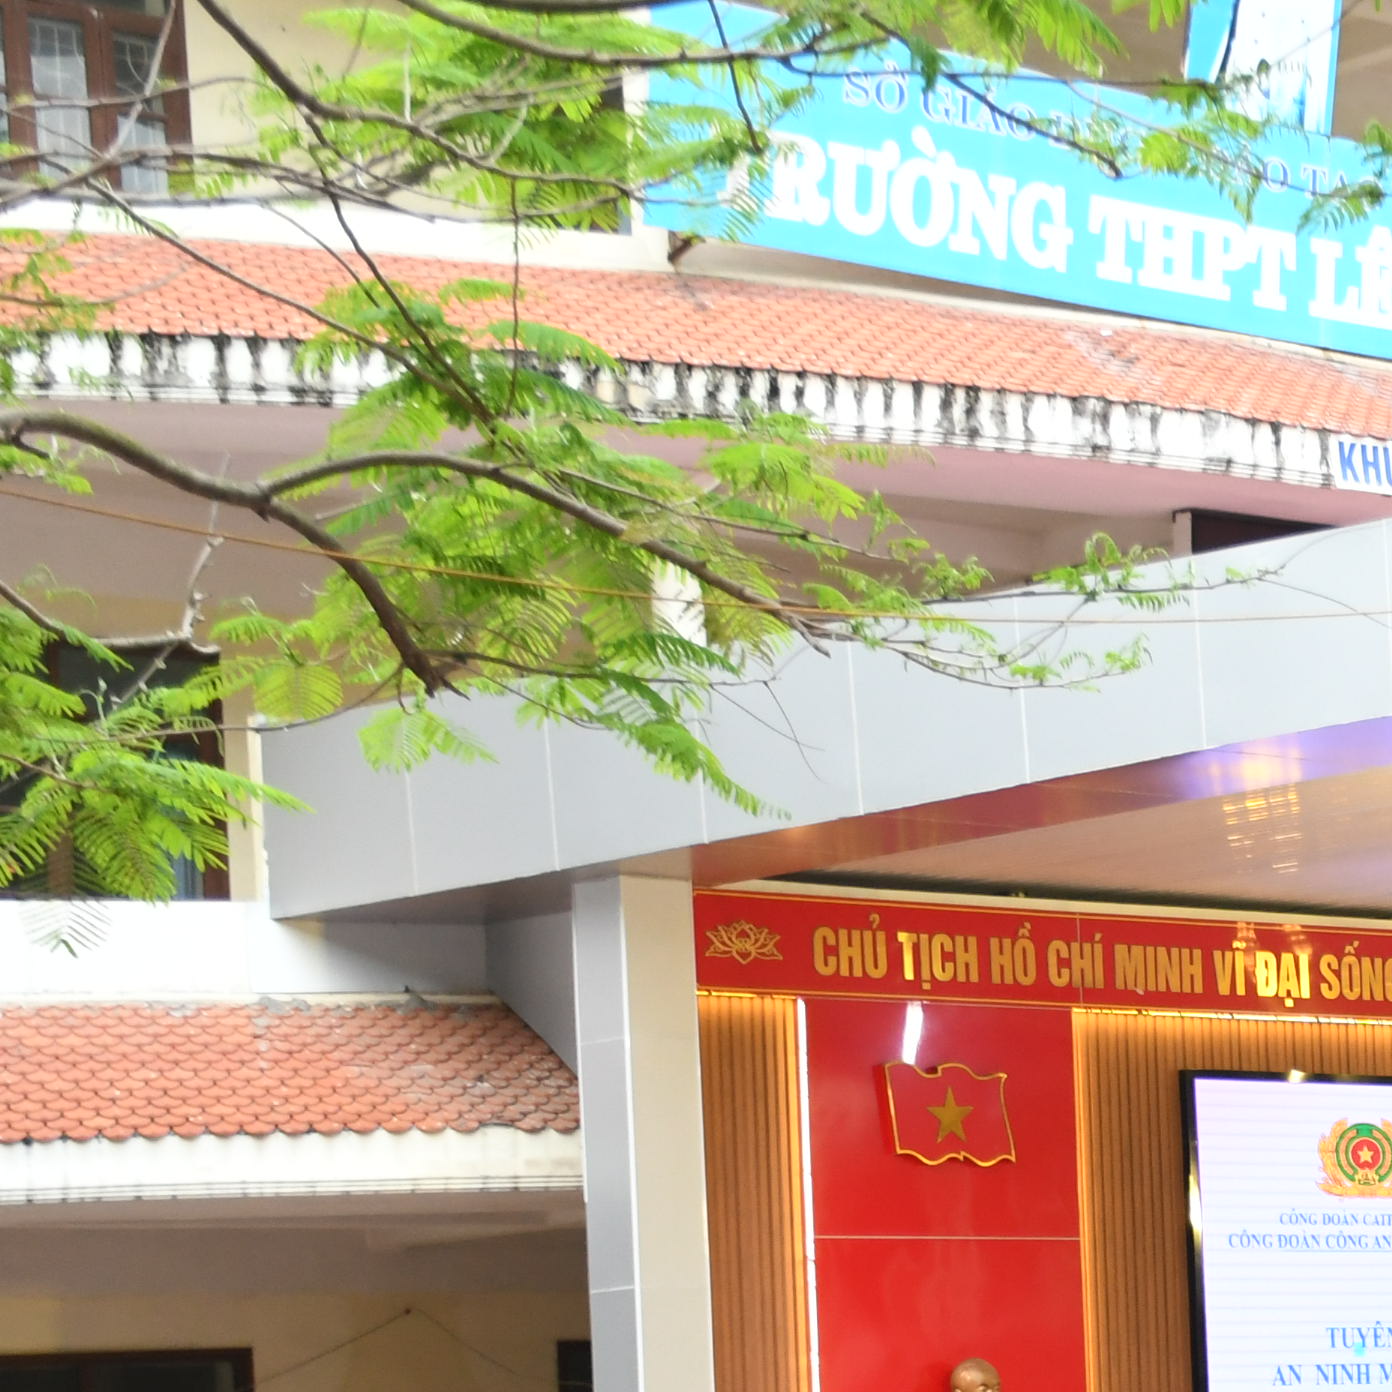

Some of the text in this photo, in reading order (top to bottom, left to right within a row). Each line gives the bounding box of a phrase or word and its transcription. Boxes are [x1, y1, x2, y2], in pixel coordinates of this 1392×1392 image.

[843, 59, 908, 114] SỞ
[922, 83, 1037, 142] GIÁO
[1088, 193, 1297, 311] THPT
[813, 913, 888, 979] CHỦ
[897, 930, 979, 990] TỊCH
[990, 921, 1037, 986] HỒ
[1047, 932, 1104, 989] CHÍ
[1114, 943, 1203, 994] MINH
[1212, 939, 1247, 996] VĨ
[1254, 949, 1311, 1008] ĐẠI
[1228, 1229, 1273, 1249] CÔNG
[1277, 1230, 1321, 1249] ĐOÀN
[1325, 1230, 1369, 1249] CÔNG
[1372, 1235, 1392, 1249] AN
[1280, 1208, 1318, 1226] CÔNG
[1272, 1364, 1303, 1387] AN
[1315, 1363, 1371, 1385] NINH
